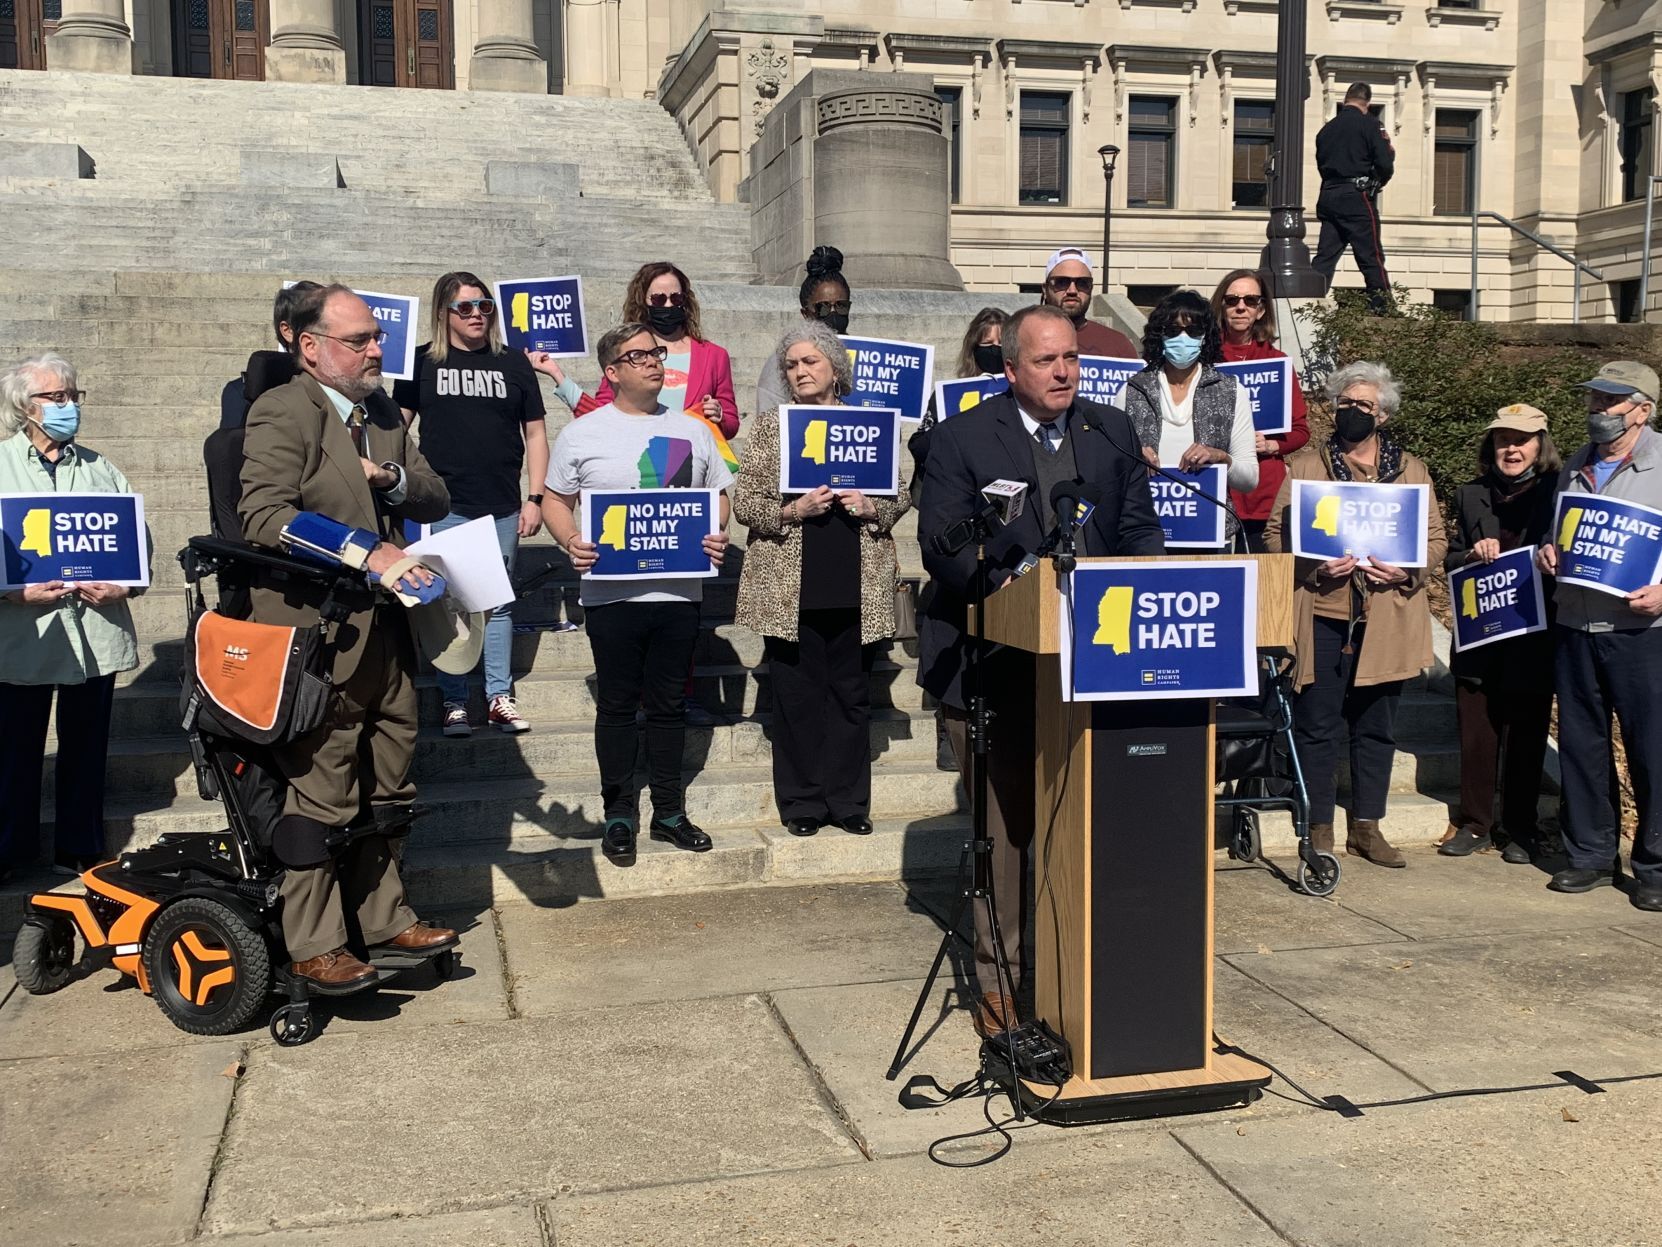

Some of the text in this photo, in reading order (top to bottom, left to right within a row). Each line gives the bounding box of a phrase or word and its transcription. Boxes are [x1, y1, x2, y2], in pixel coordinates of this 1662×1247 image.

[531, 294, 572, 311] STOP
[368, 305, 402, 322] ATE
[533, 313, 573, 330] HATE
[858, 350, 920, 369] NO HATE
[857, 364, 901, 380] IN MY
[1080, 366, 1099, 379] NO
[1243, 370, 1280, 385] HATE
[436, 368, 507, 399] GO GAYS
[856, 379, 899, 395] STATE
[1078, 380, 1119, 394] IN MY
[829, 425, 880, 443] STOP
[830, 445, 877, 463] HATE
[1149, 481, 1201, 498] STOP
[629, 503, 703, 518] NO HATE
[1343, 500, 1402, 518] STOP
[54, 512, 119, 531] STOP
[630, 519, 679, 534] IN MY
[1342, 520, 1398, 537] HATE
[1582, 508, 1662, 541] NO HATE
[56, 534, 119, 553] HATE
[630, 536, 679, 551] STATE
[1577, 525, 1632, 547] IN MY
[1572, 541, 1626, 565] STATE
[1476, 568, 1518, 594] STOP
[1137, 591, 1220, 618] STOP
[1479, 588, 1518, 614] HATE
[1138, 623, 1216, 649] HATE
[224, 644, 249, 661] MS
